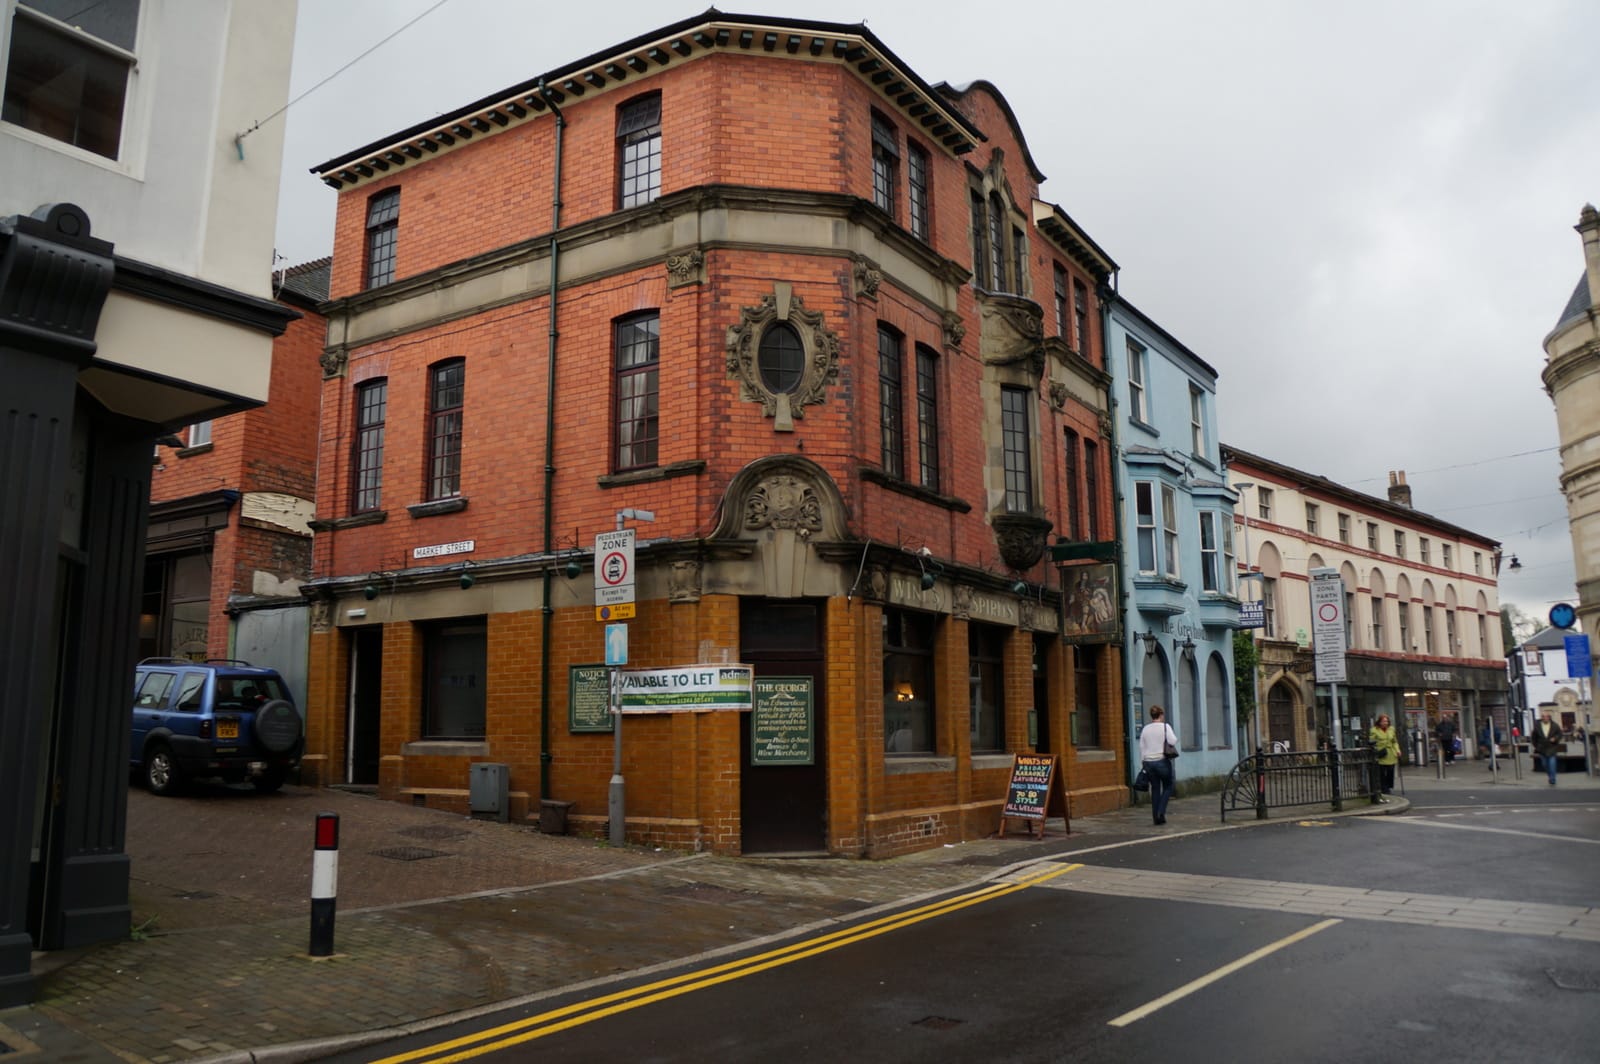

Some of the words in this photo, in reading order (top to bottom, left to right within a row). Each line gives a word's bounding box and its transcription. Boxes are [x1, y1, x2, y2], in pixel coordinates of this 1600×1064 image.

[598, 531, 633, 541] PEDESTRIAN
[416, 545, 443, 557] MARKET
[446, 542, 471, 554] STREET
[602, 539, 627, 550] ZONE
[972, 596, 1014, 619] SPIRITS
[579, 670, 605, 678] NOTICE
[671, 674, 689, 686] TO
[693, 673, 714, 685] LET
[756, 684, 774, 692] THE
[775, 684, 808, 692] GEORGE
[1018, 804, 1044, 814] WELCOME
